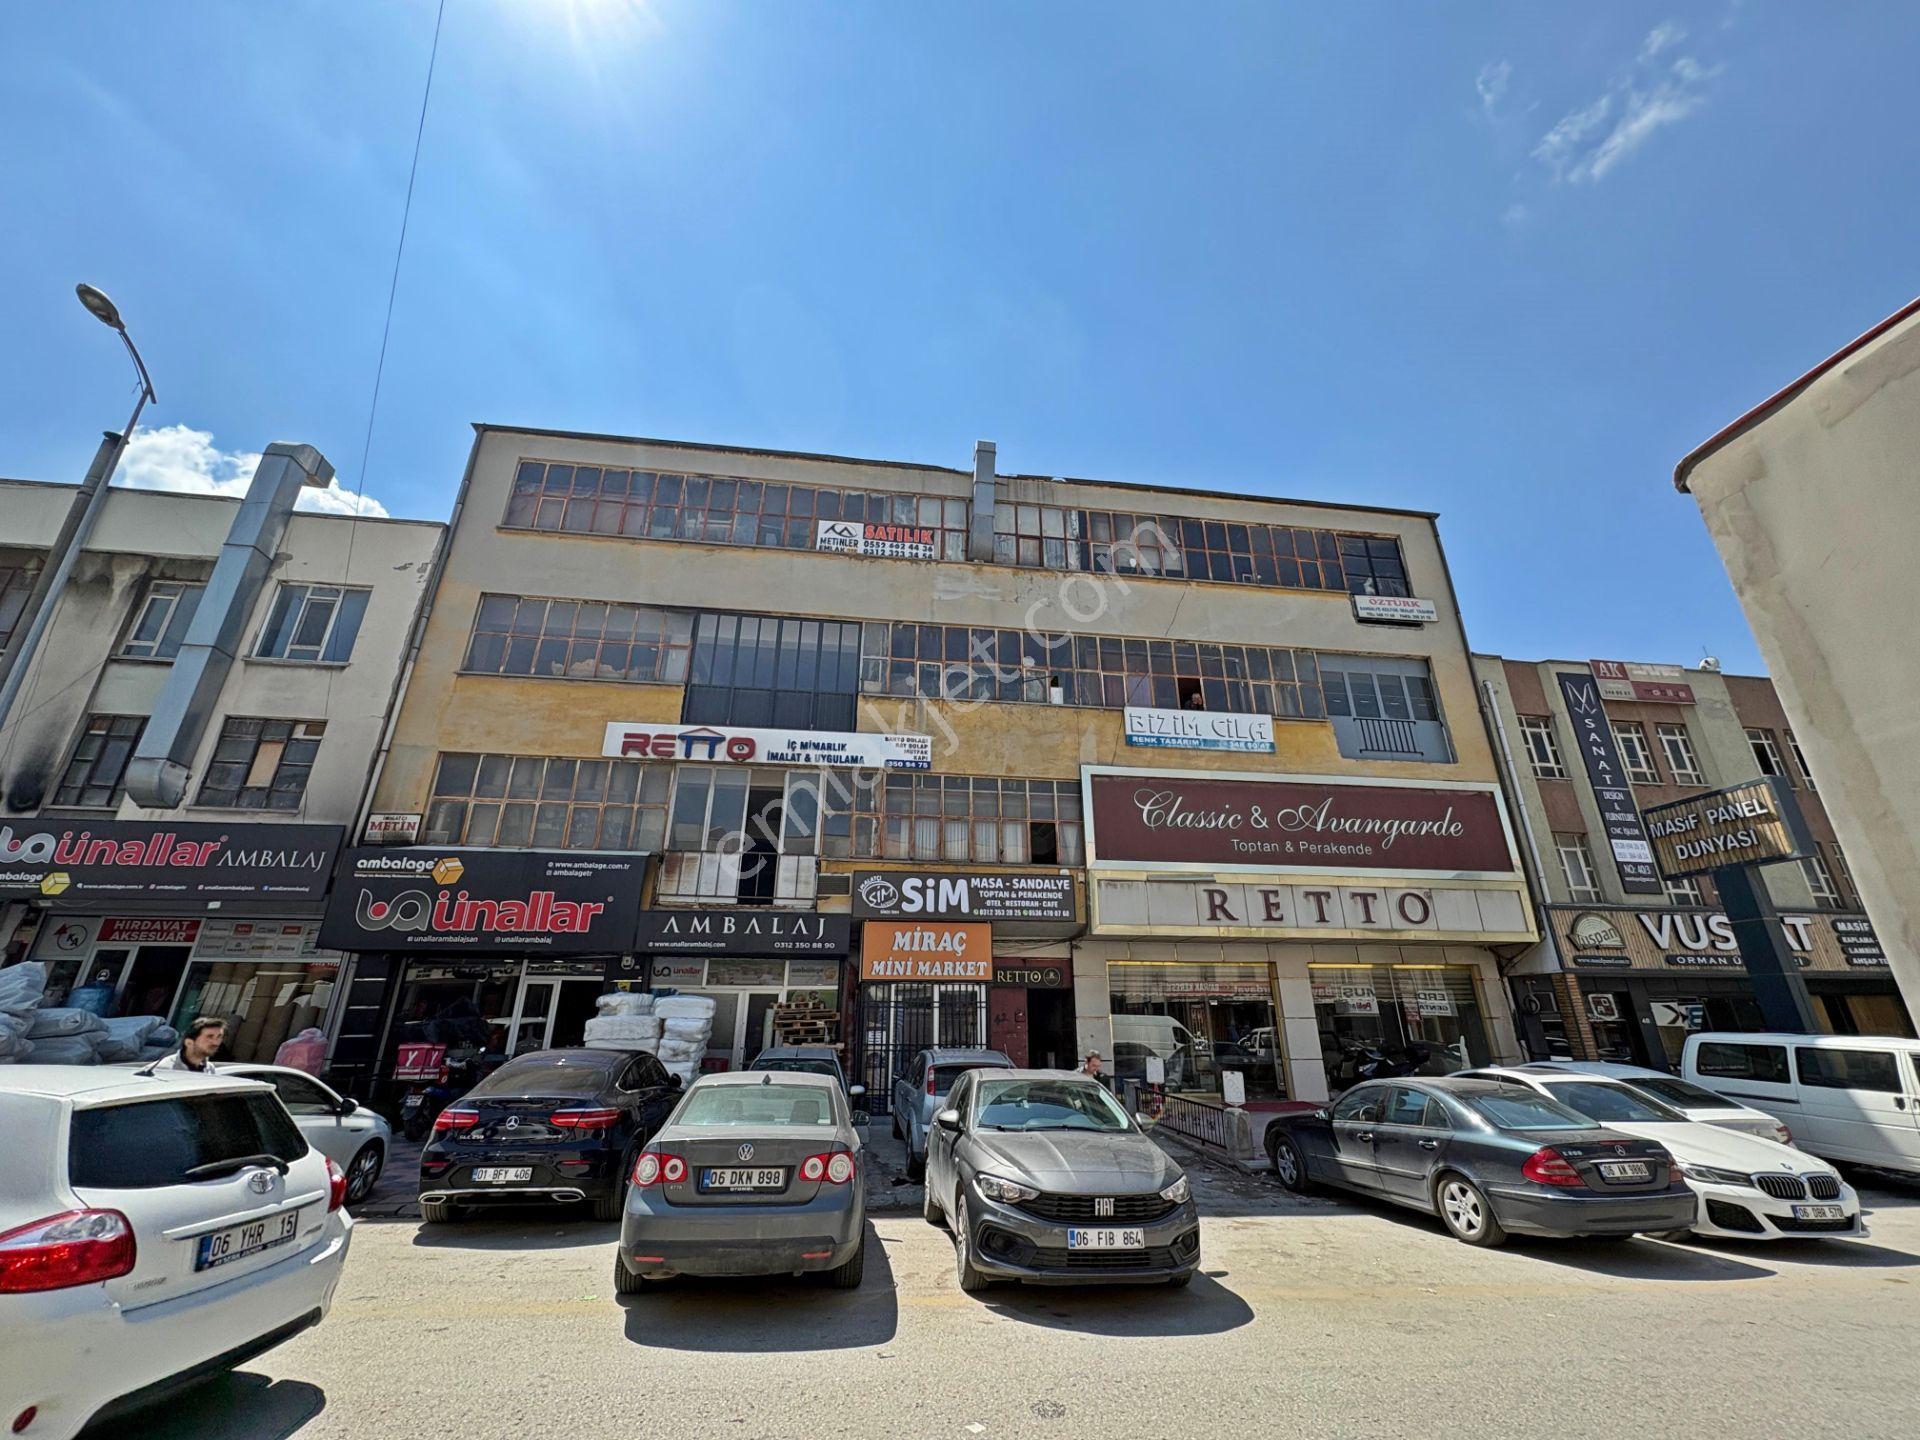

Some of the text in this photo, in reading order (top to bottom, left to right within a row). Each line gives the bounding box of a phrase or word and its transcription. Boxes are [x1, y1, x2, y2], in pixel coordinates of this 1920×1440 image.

[864, 525, 933, 544] SATILIK
[1369, 597, 1420, 608] ÖZTÜRK
[1599, 662, 1623, 678] AK
[800, 739, 848, 751] MİMARLIK
[1584, 718, 1612, 784] SANAT
[767, 750, 801, 762] İMALAT
[815, 754, 865, 764] UYGULAMA
[1134, 788, 1464, 850] Classic & Avangarde
[1706, 798, 1768, 825] PANEL
[54, 831, 326, 872] ünallar AMBALAJ
[1231, 839, 1372, 856] Toptan & Perakende
[357, 856, 435, 872] ambalage
[555, 861, 630, 870] www.ambalage.com.tr
[553, 869, 593, 877] ambalagetr
[971, 878, 1004, 889] MASA
[1012, 878, 1070, 890] SANDALYE
[979, 890, 1010, 899] TOPTAN
[1018, 891, 1063, 899] PERAKENDE
[432, 890, 604, 933] ünallar
[1203, 887, 1431, 926] RETTO
[114, 920, 190, 931] HIRDAVAT
[662, 916, 826, 939] AMBALAJ
[110, 931, 187, 942] AKSESUAR
[892, 926, 967, 957] MİRAÇ
[870, 956, 987, 977] MİNİ MARKET
[1677, 956, 1727, 965] ORMAN
[997, 970, 1041, 983] RETTO
[477, 1169, 531, 1180] 01 BFY 406
[711, 1170, 780, 1185] 06 DKN 898
[1095, 1197, 1116, 1217] FIAT
[211, 1233, 231, 1257] 06
[240, 1223, 265, 1249] YHR
[280, 1214, 294, 1236] 15
[1076, 1231, 1141, 1246] 06 FIB 864
